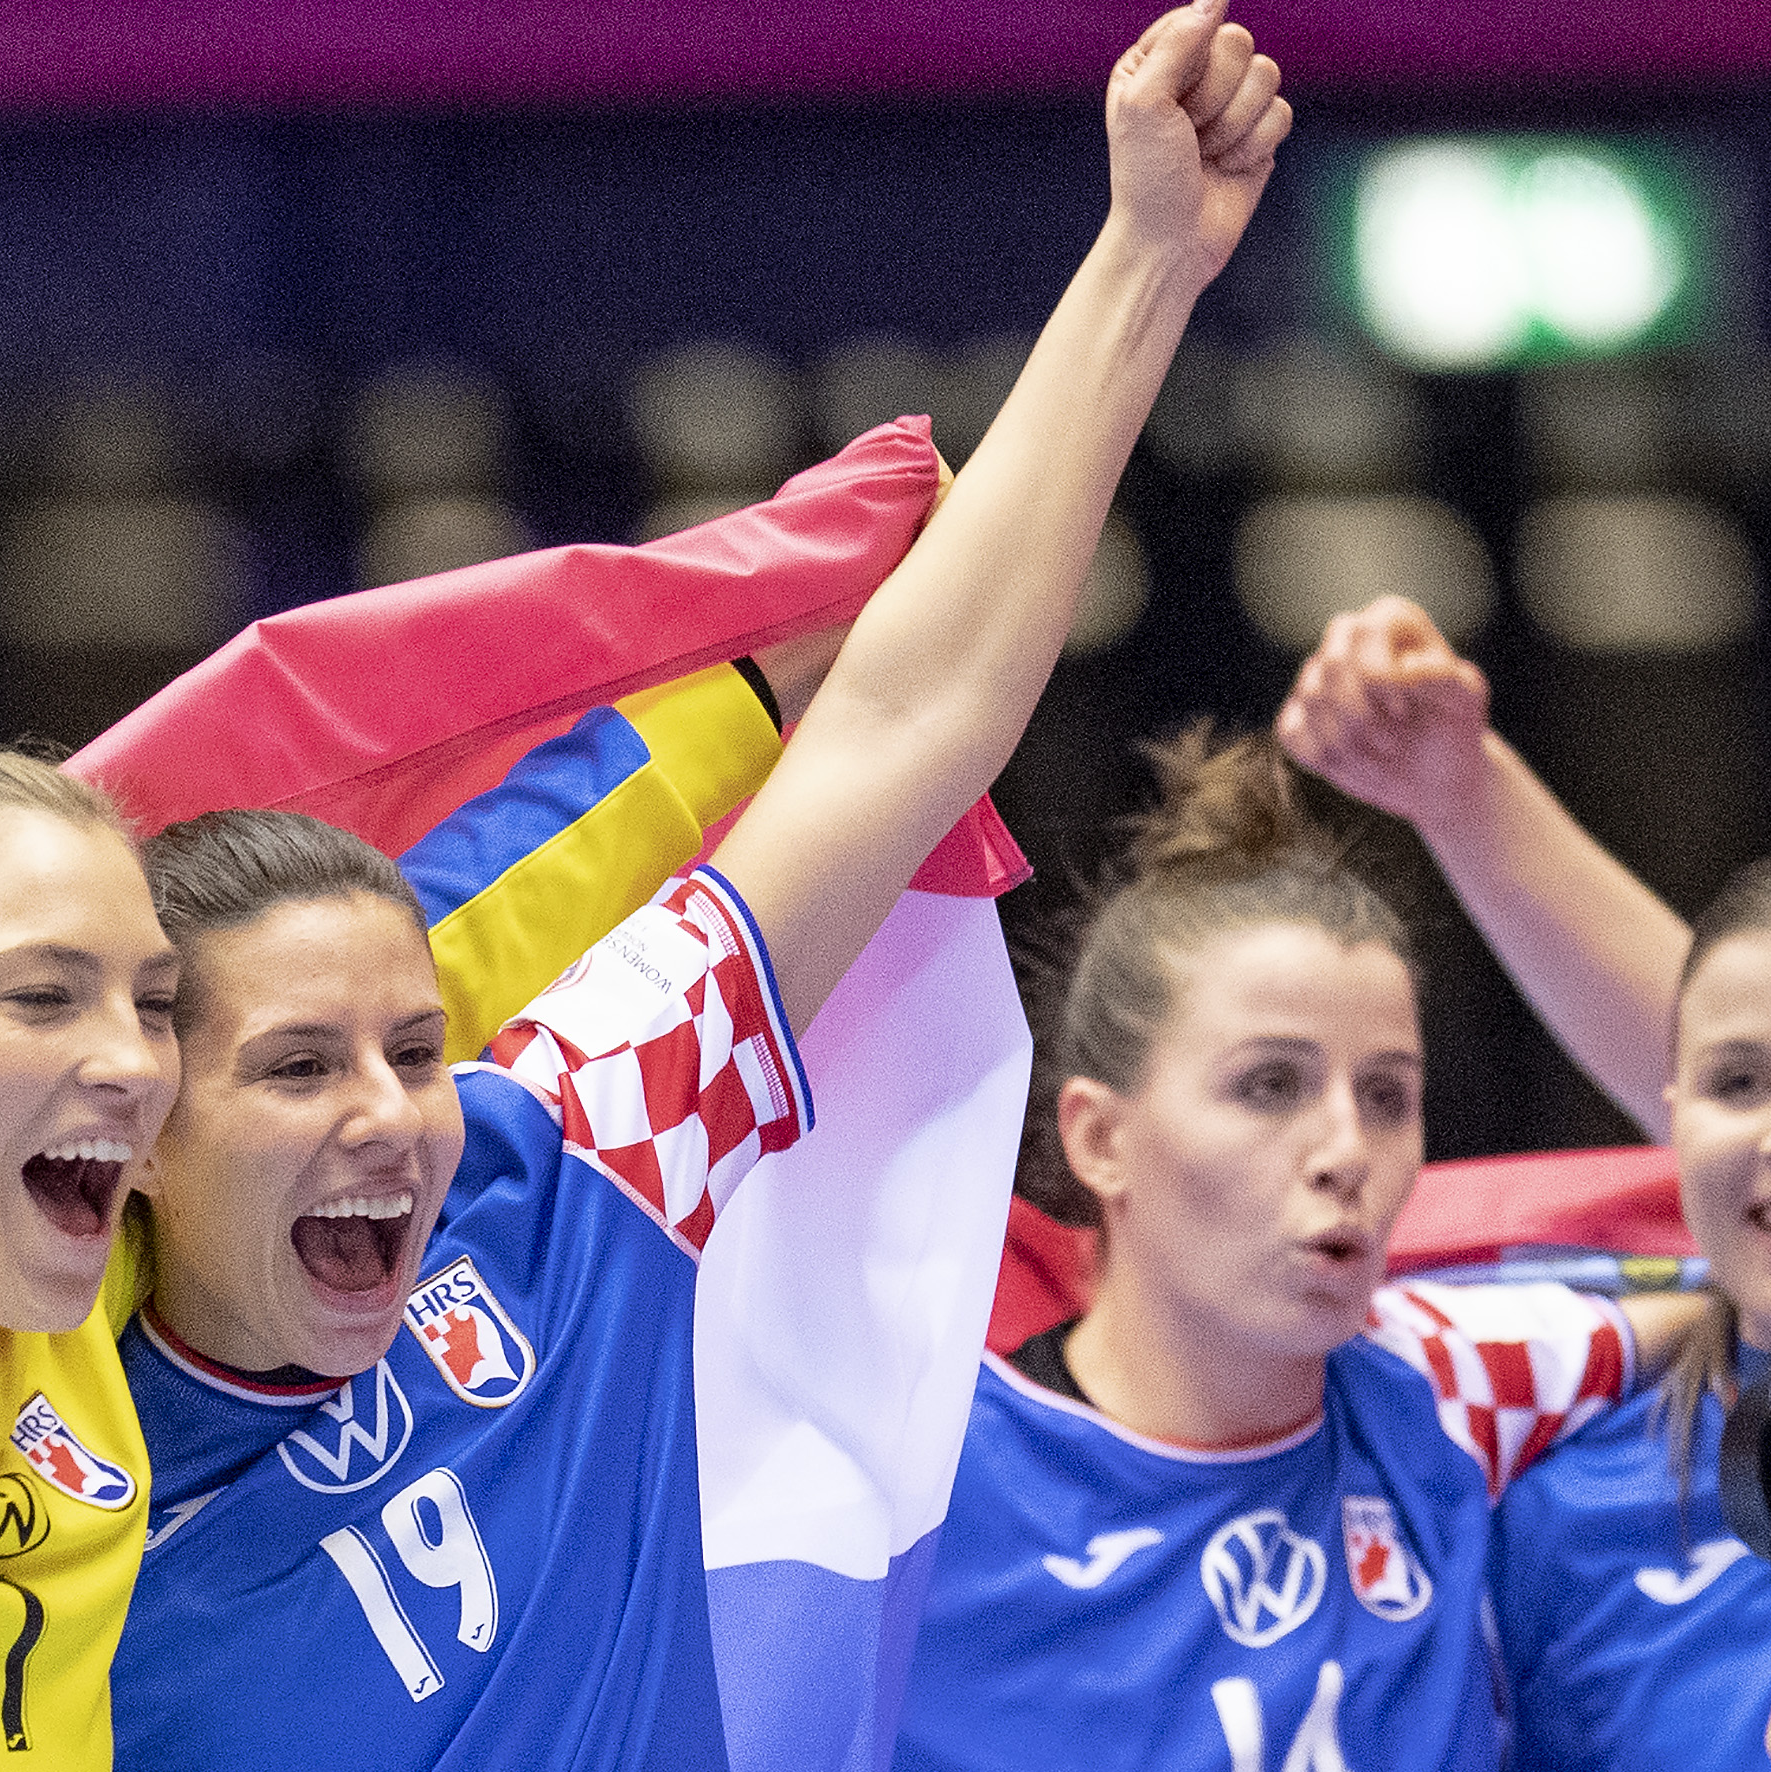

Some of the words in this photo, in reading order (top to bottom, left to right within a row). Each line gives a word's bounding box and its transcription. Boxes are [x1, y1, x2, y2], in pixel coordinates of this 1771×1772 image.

[407, 1270, 476, 1326] HRS
[9, 1404, 58, 1452] HRS
[319, 1466, 499, 1702] 19
